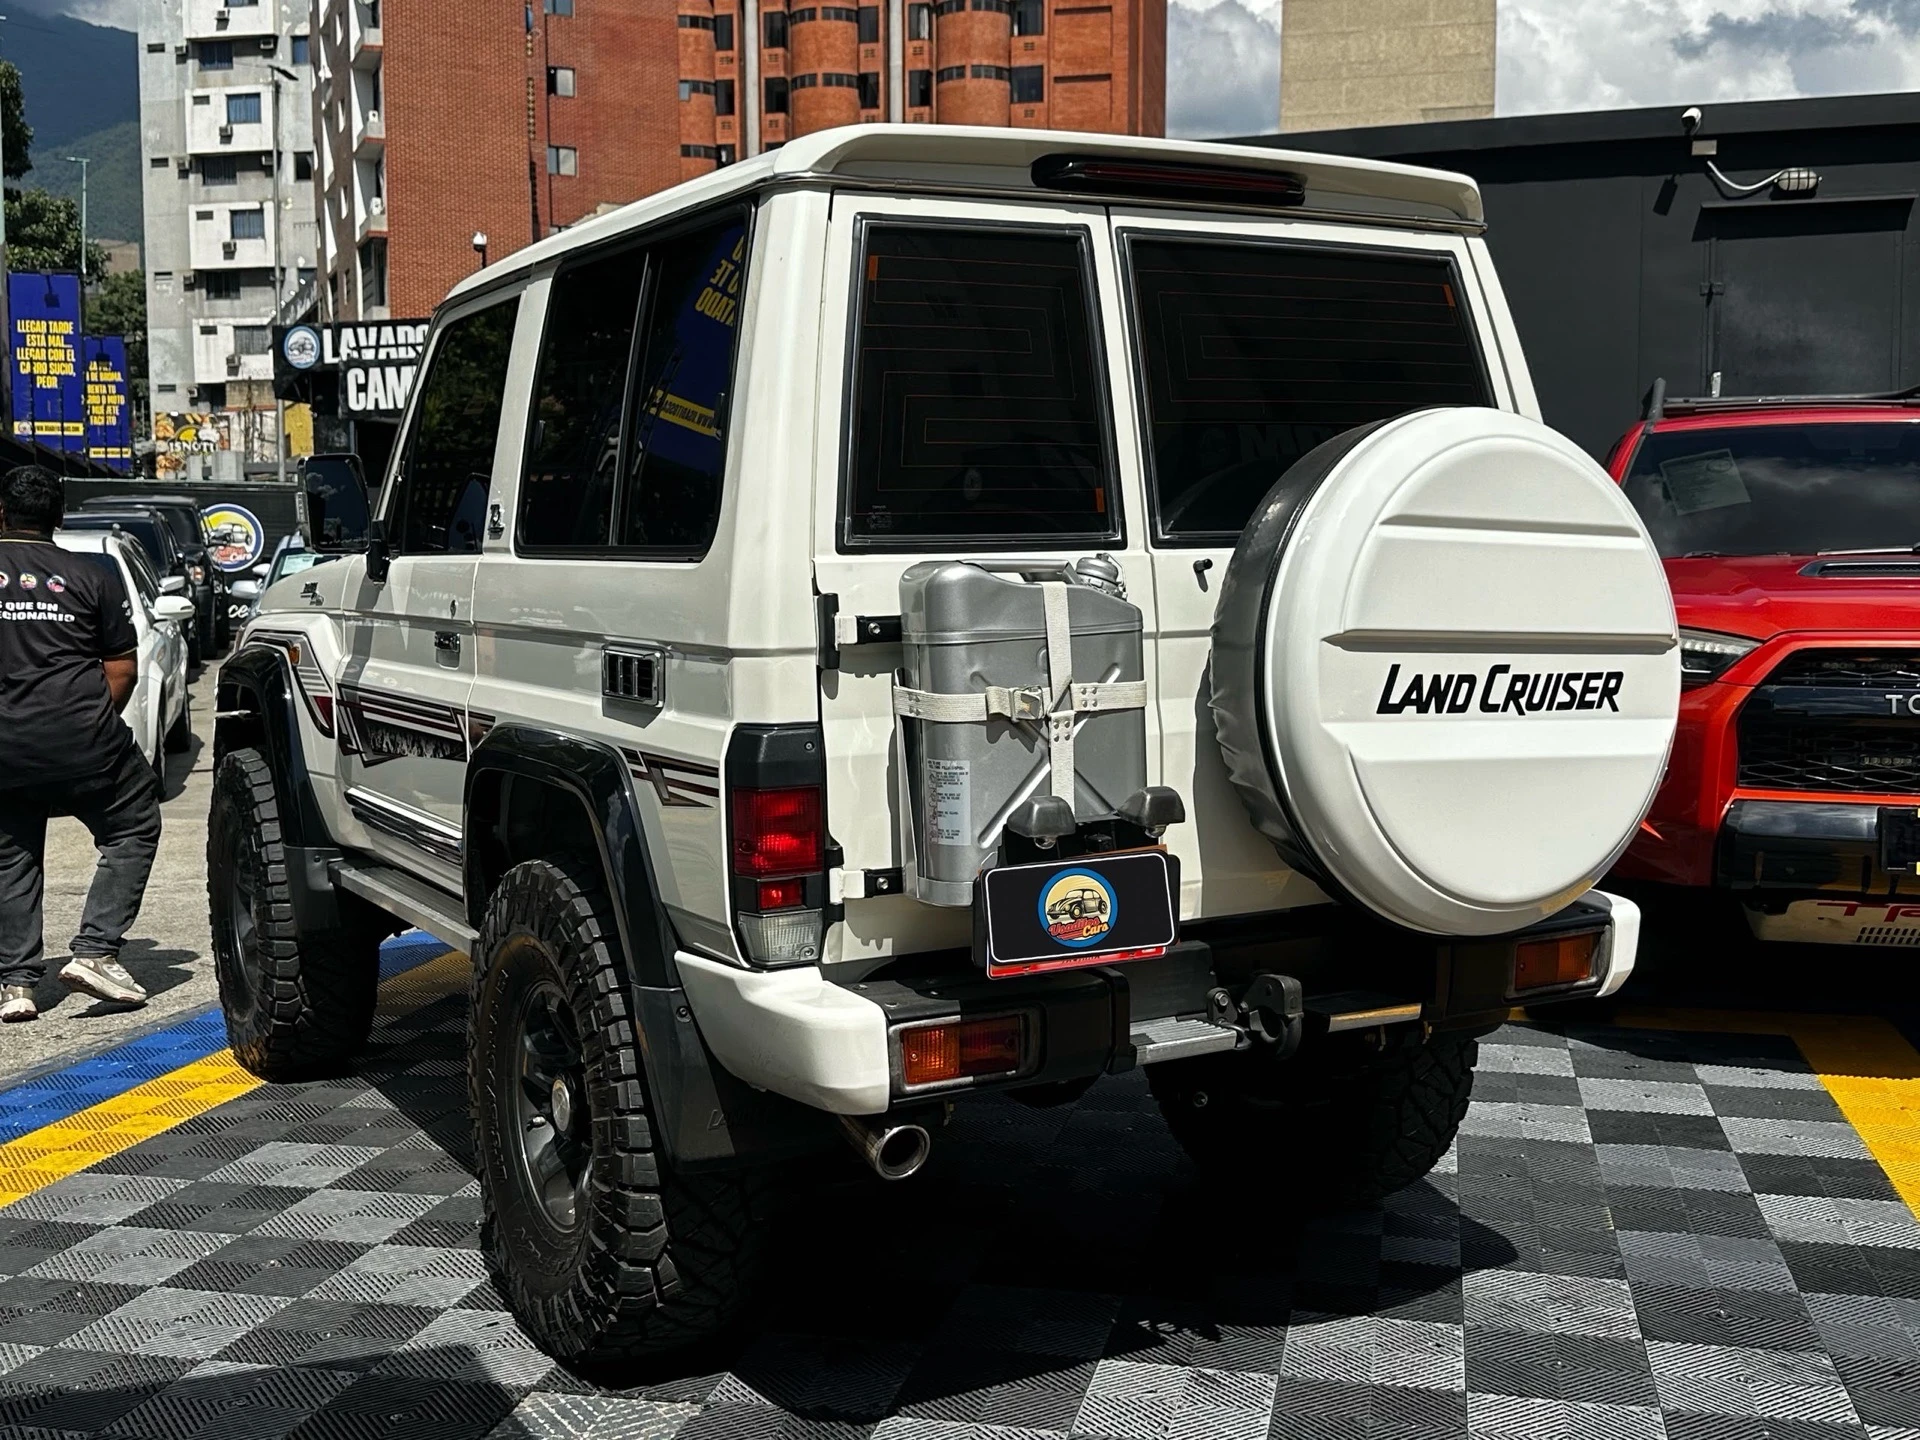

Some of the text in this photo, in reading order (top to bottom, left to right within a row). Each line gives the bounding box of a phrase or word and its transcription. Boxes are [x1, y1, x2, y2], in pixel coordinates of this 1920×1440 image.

[17, 320, 74, 335] LLEGAR TARDE
[17, 347, 76, 362] LLEGAR CON EL
[36, 375, 58, 389] PEOR
[346, 365, 418, 412] CAM
[5, 601, 34, 611] QUE
[36, 601, 59, 612] UN
[1376, 663, 1624, 716] LAND CRUISER
[1082, 921, 1110, 937] Cars
